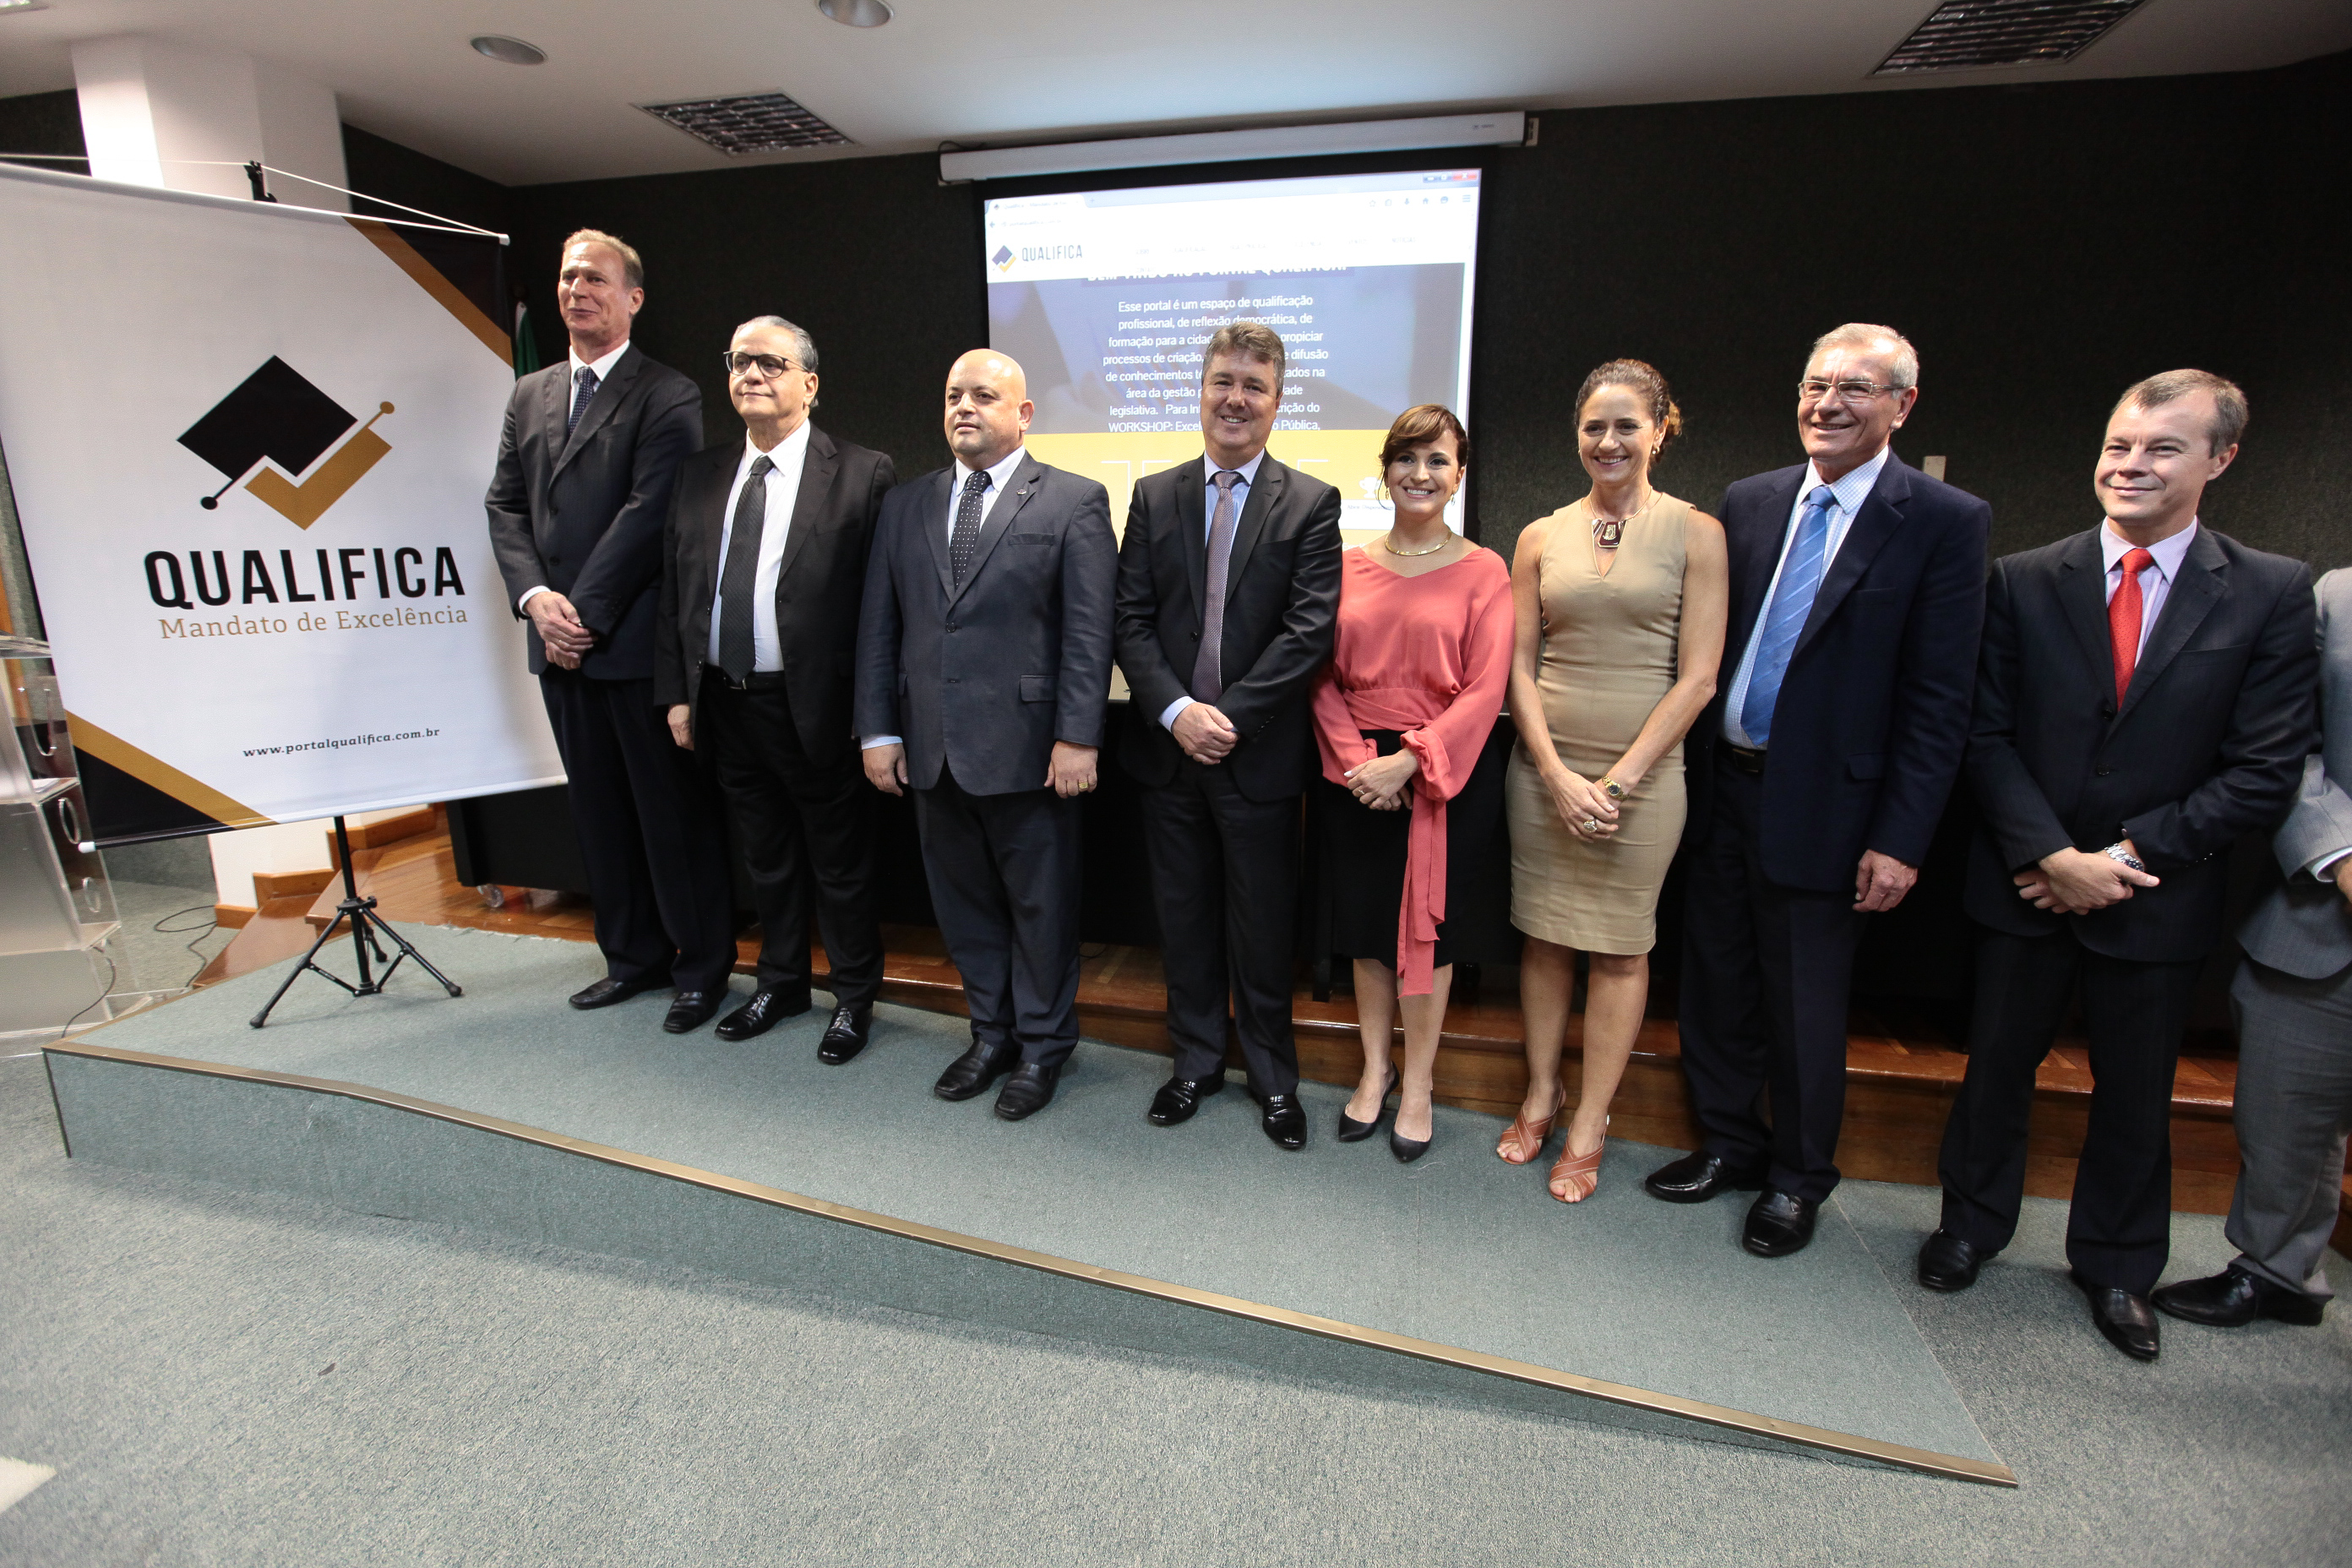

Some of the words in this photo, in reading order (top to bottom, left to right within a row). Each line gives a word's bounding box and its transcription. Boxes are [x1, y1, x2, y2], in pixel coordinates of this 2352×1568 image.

[1021, 244, 1083, 262] QUALIFICA
[1118, 301, 1141, 313] Esse
[1143, 299, 1171, 313] portal
[1173, 298, 1179, 310] é
[1181, 300, 1198, 310] um
[1200, 299, 1235, 310] espaço
[1238, 297, 1250, 308] de
[1252, 295, 1313, 308] qualificação
[1118, 317, 1175, 331] profissional,
[1177, 317, 1190, 328] de
[1191, 316, 1231, 327] reflexão
[1299, 313, 1313, 324] de
[1108, 336, 1153, 349] formação
[1155, 336, 1177, 347] para
[1179, 336, 1185, 346] a
[1187, 333, 1213, 345] cidad
[1102, 355, 1151, 367] processos
[1152, 353, 1165, 363] de
[1167, 352, 1205, 364] criação,
[1291, 349, 1329, 360] difusão
[1105, 372, 1118, 382] de
[1119, 370, 1193, 381] conhecimentos
[1312, 368, 1326, 377] na
[1125, 388, 1146, 399] área
[1148, 388, 1161, 398] da
[1162, 387, 1195, 400] gestão
[1109, 405, 1159, 418] legislativa.
[1165, 404, 1188, 415] Para
[1307, 401, 1320, 412] do
[1108, 422, 1173, 433] WORKSHOP:
[1281, 419, 1320, 431] Pública,
[144, 546, 466, 610] QUALIFICA
[158, 615, 288, 639] Mandato
[297, 612, 327, 632] de
[335, 605, 468, 629] Excelência
[242, 728, 440, 757] www.portalqualifica.com.br
